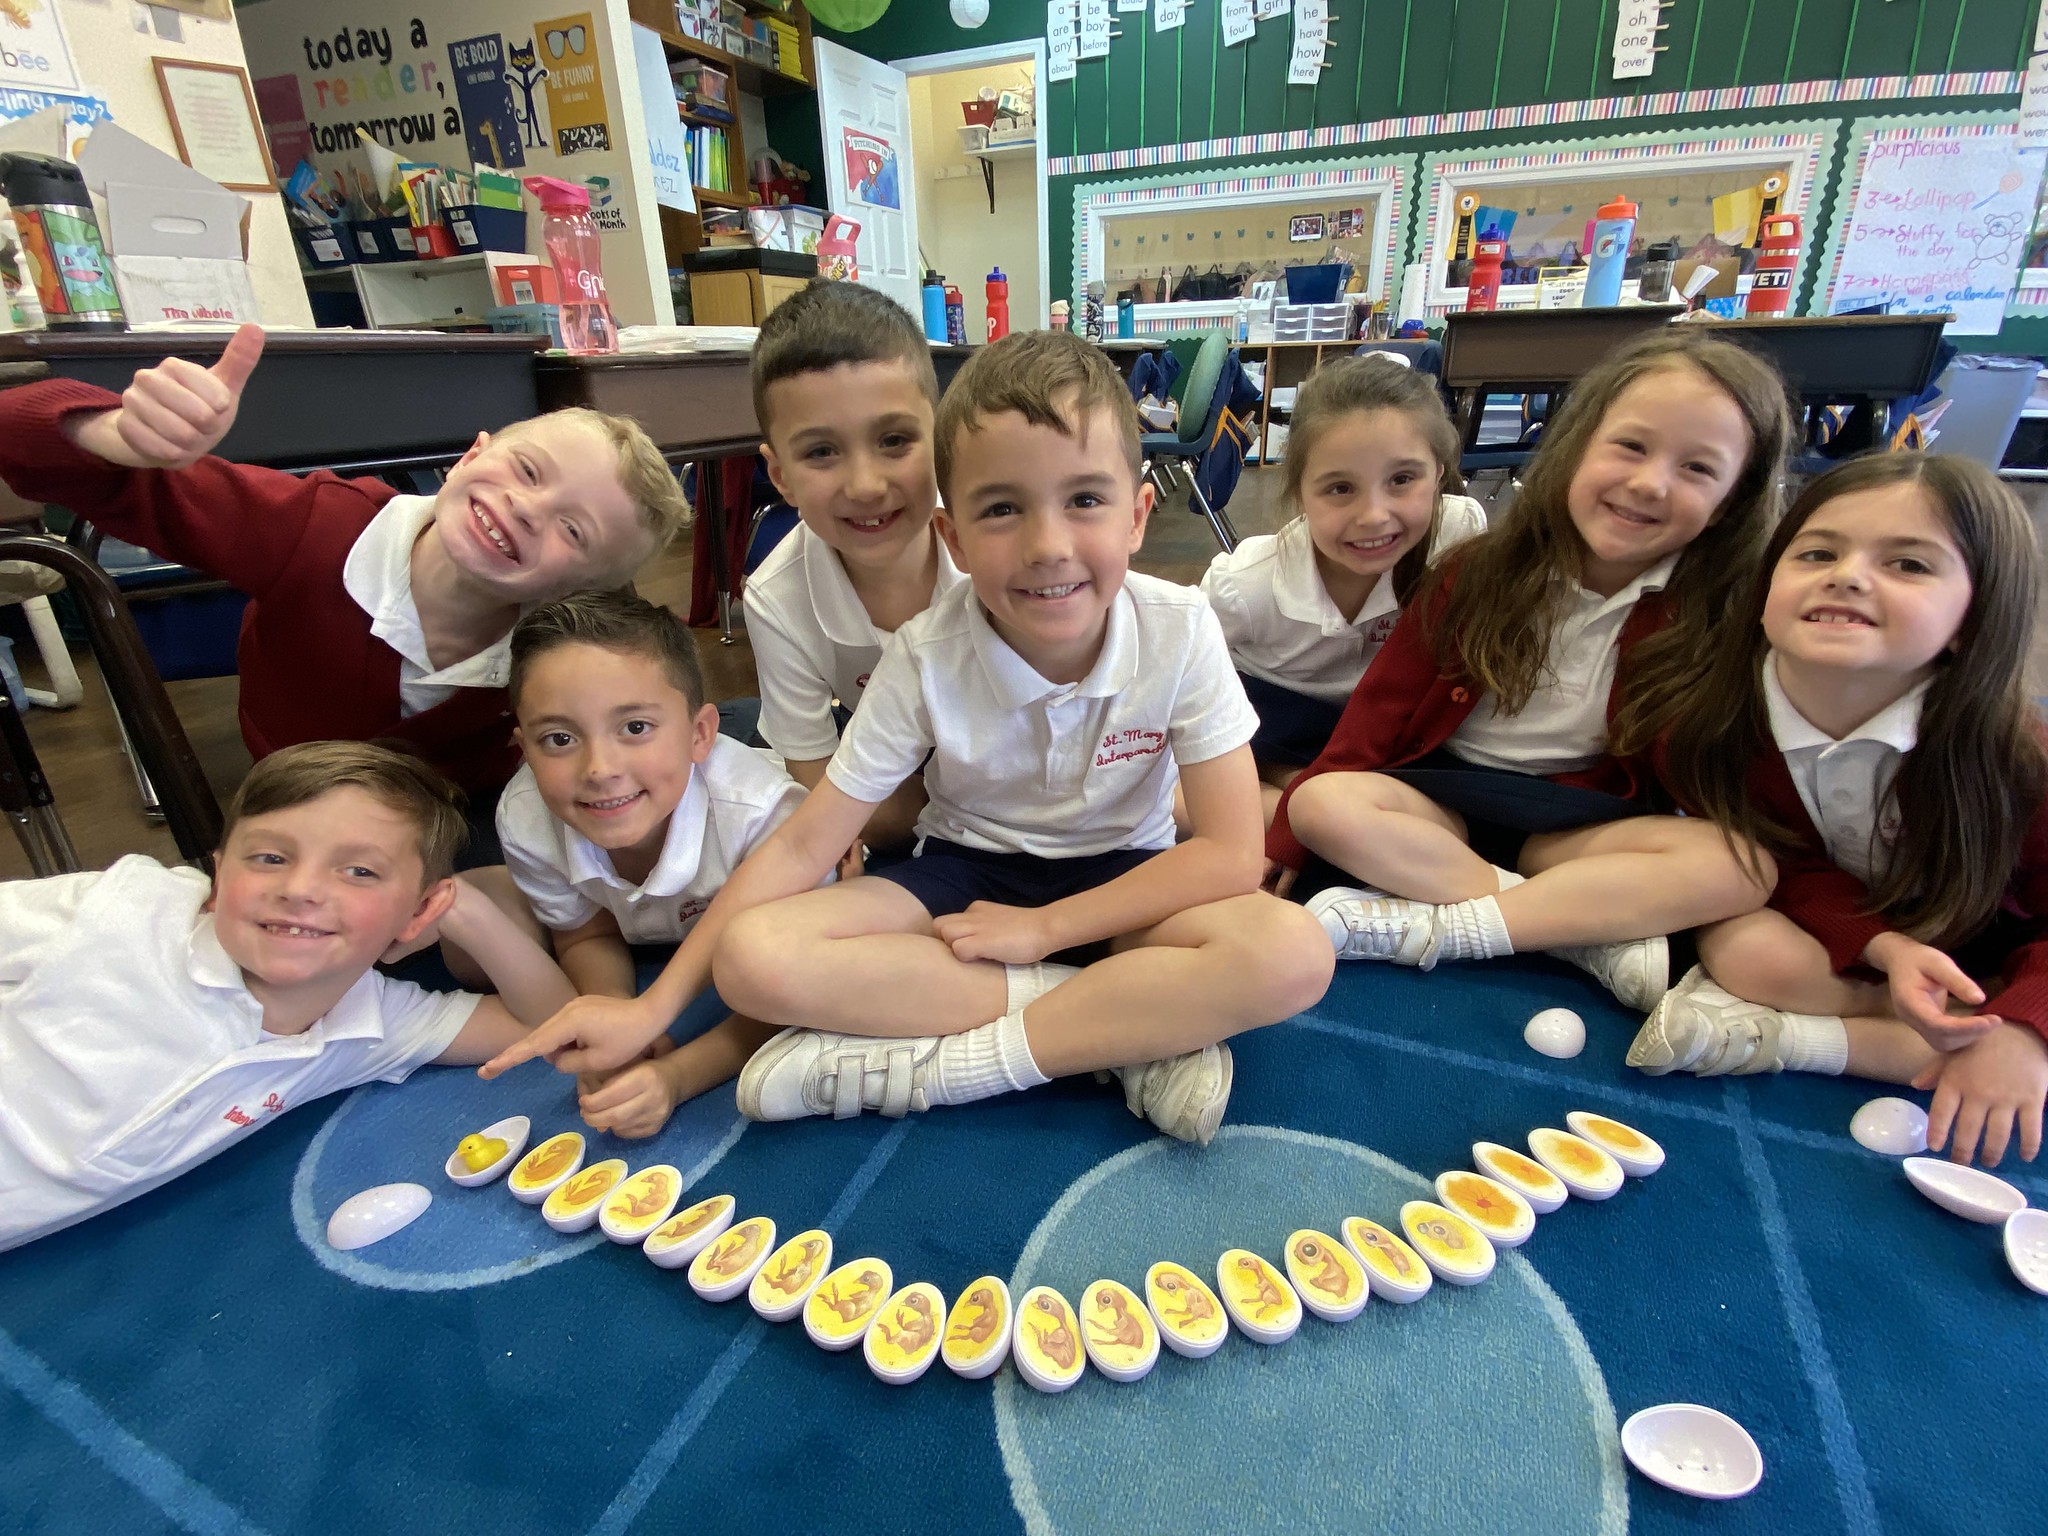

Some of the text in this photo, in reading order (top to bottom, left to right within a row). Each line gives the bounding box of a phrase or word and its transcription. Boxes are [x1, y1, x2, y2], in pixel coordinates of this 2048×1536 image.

[1058, 6, 1065, 15] a
[1088, 3, 1100, 15] be
[1226, 5, 1248, 18] from
[1303, 7, 1319, 20] he
[1160, 9, 1181, 23] day
[1629, 11, 1647, 27] oh
[1052, 25, 1070, 37] are
[1086, 20, 1106, 32] boy
[1229, 23, 1249, 37] four
[1299, 28, 1323, 40] have
[303, 18, 429, 71] today a
[1053, 40, 1073, 53] any
[1082, 39, 1108, 51] before
[1621, 36, 1648, 48] one
[454, 39, 498, 69] BE BOLD
[1296, 46, 1322, 59] how
[1051, 63, 1073, 75] about
[1621, 57, 1648, 69] over
[551, 64, 595, 89] BE FUNNY
[1293, 66, 1315, 78] here
[312, 61, 445, 110] reader,
[443, 106, 461, 137] a
[1863, 187, 1977, 214] 3 Lollipop
[588, 207, 621, 220] ooks of
[1854, 223, 1869, 242] 5
[1894, 222, 1946, 243] Stuffy
[1927, 242, 1954, 264] day
[1103, 729, 1164, 748] St. Mary
